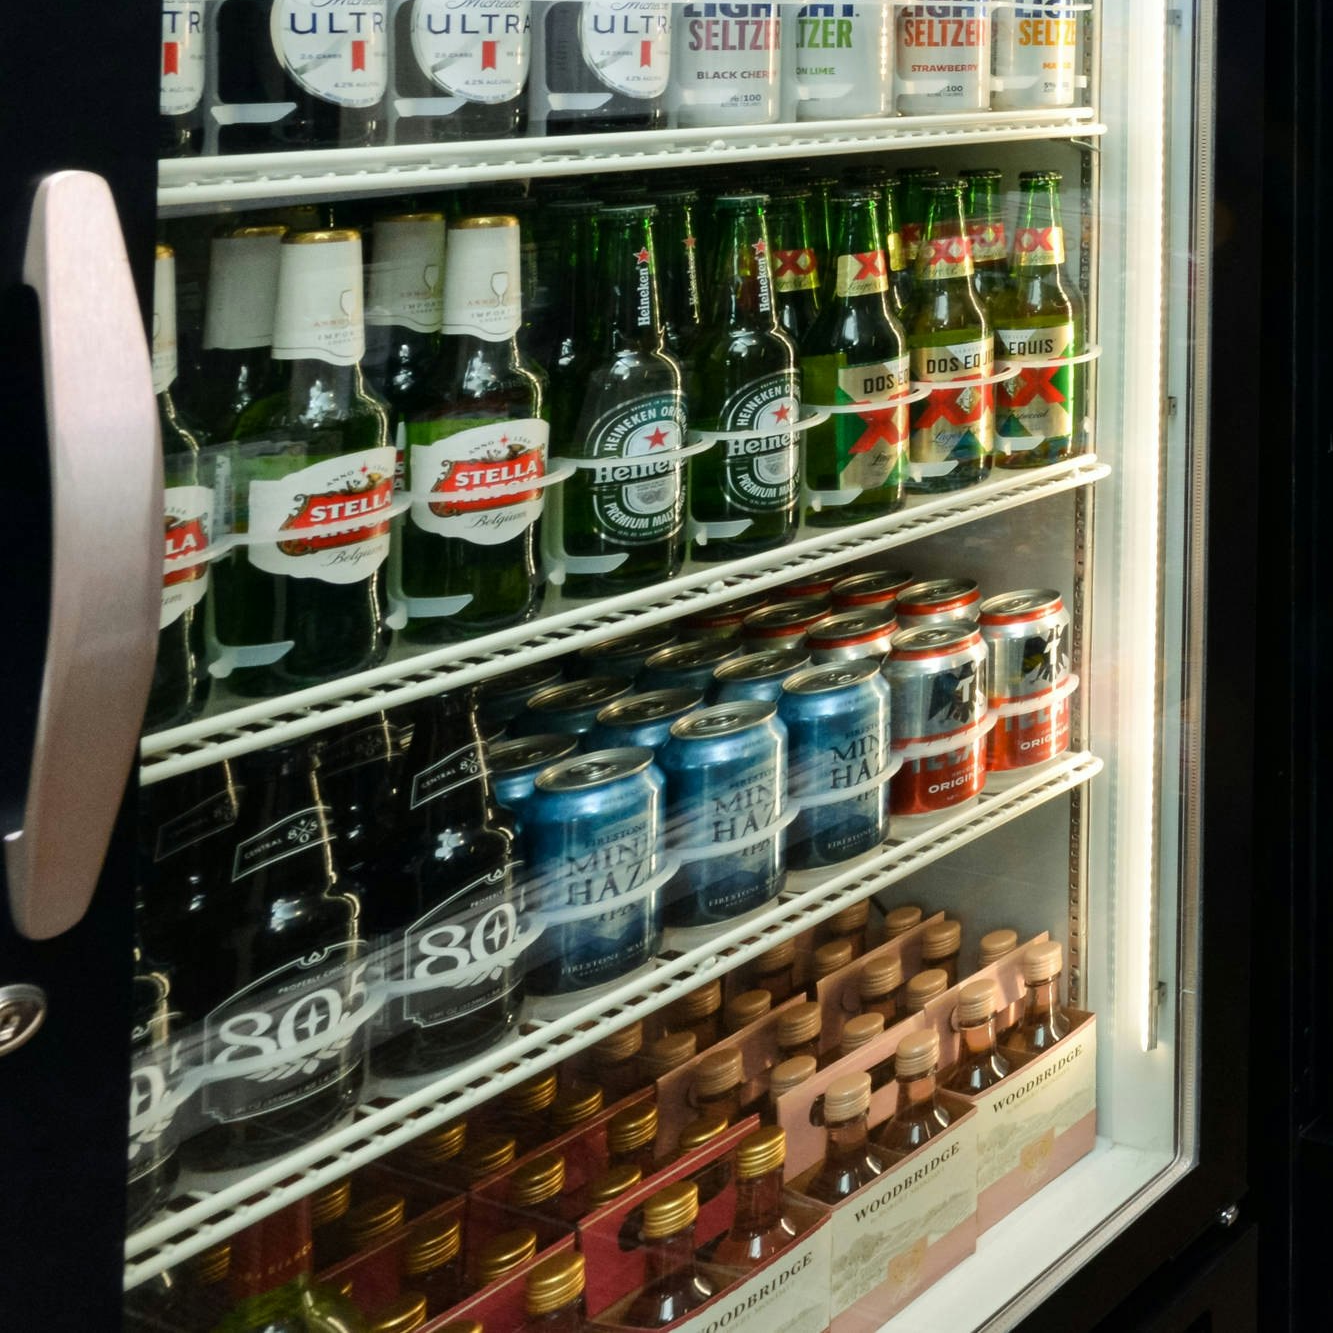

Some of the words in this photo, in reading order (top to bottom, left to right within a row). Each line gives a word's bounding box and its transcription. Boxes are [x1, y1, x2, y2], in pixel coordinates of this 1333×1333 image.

[696, 70, 738, 80] BLACK
[809, 67, 835, 75] LIME
[911, 64, 979, 73] STRAWBERRY
[637, 266, 651, 327] Heineken
[758, 256, 770, 313] Heineken
[1009, 338, 1055, 357] EQUIS
[926, 358, 960, 375] DOS
[863, 372, 894, 396] DOS
[736, 384, 782, 427] HEINEKEN
[603, 407, 659, 451] HEINEKEN
[455, 460, 539, 487] STELLA
[736, 472, 777, 499] PREMIUM
[310, 490, 392, 523] STELLA
[603, 501, 650, 530] PREMIUM
[991, 1042, 1084, 1114] WOODBRIDGE
[853, 1140, 961, 1224] WOODBRIDGE
